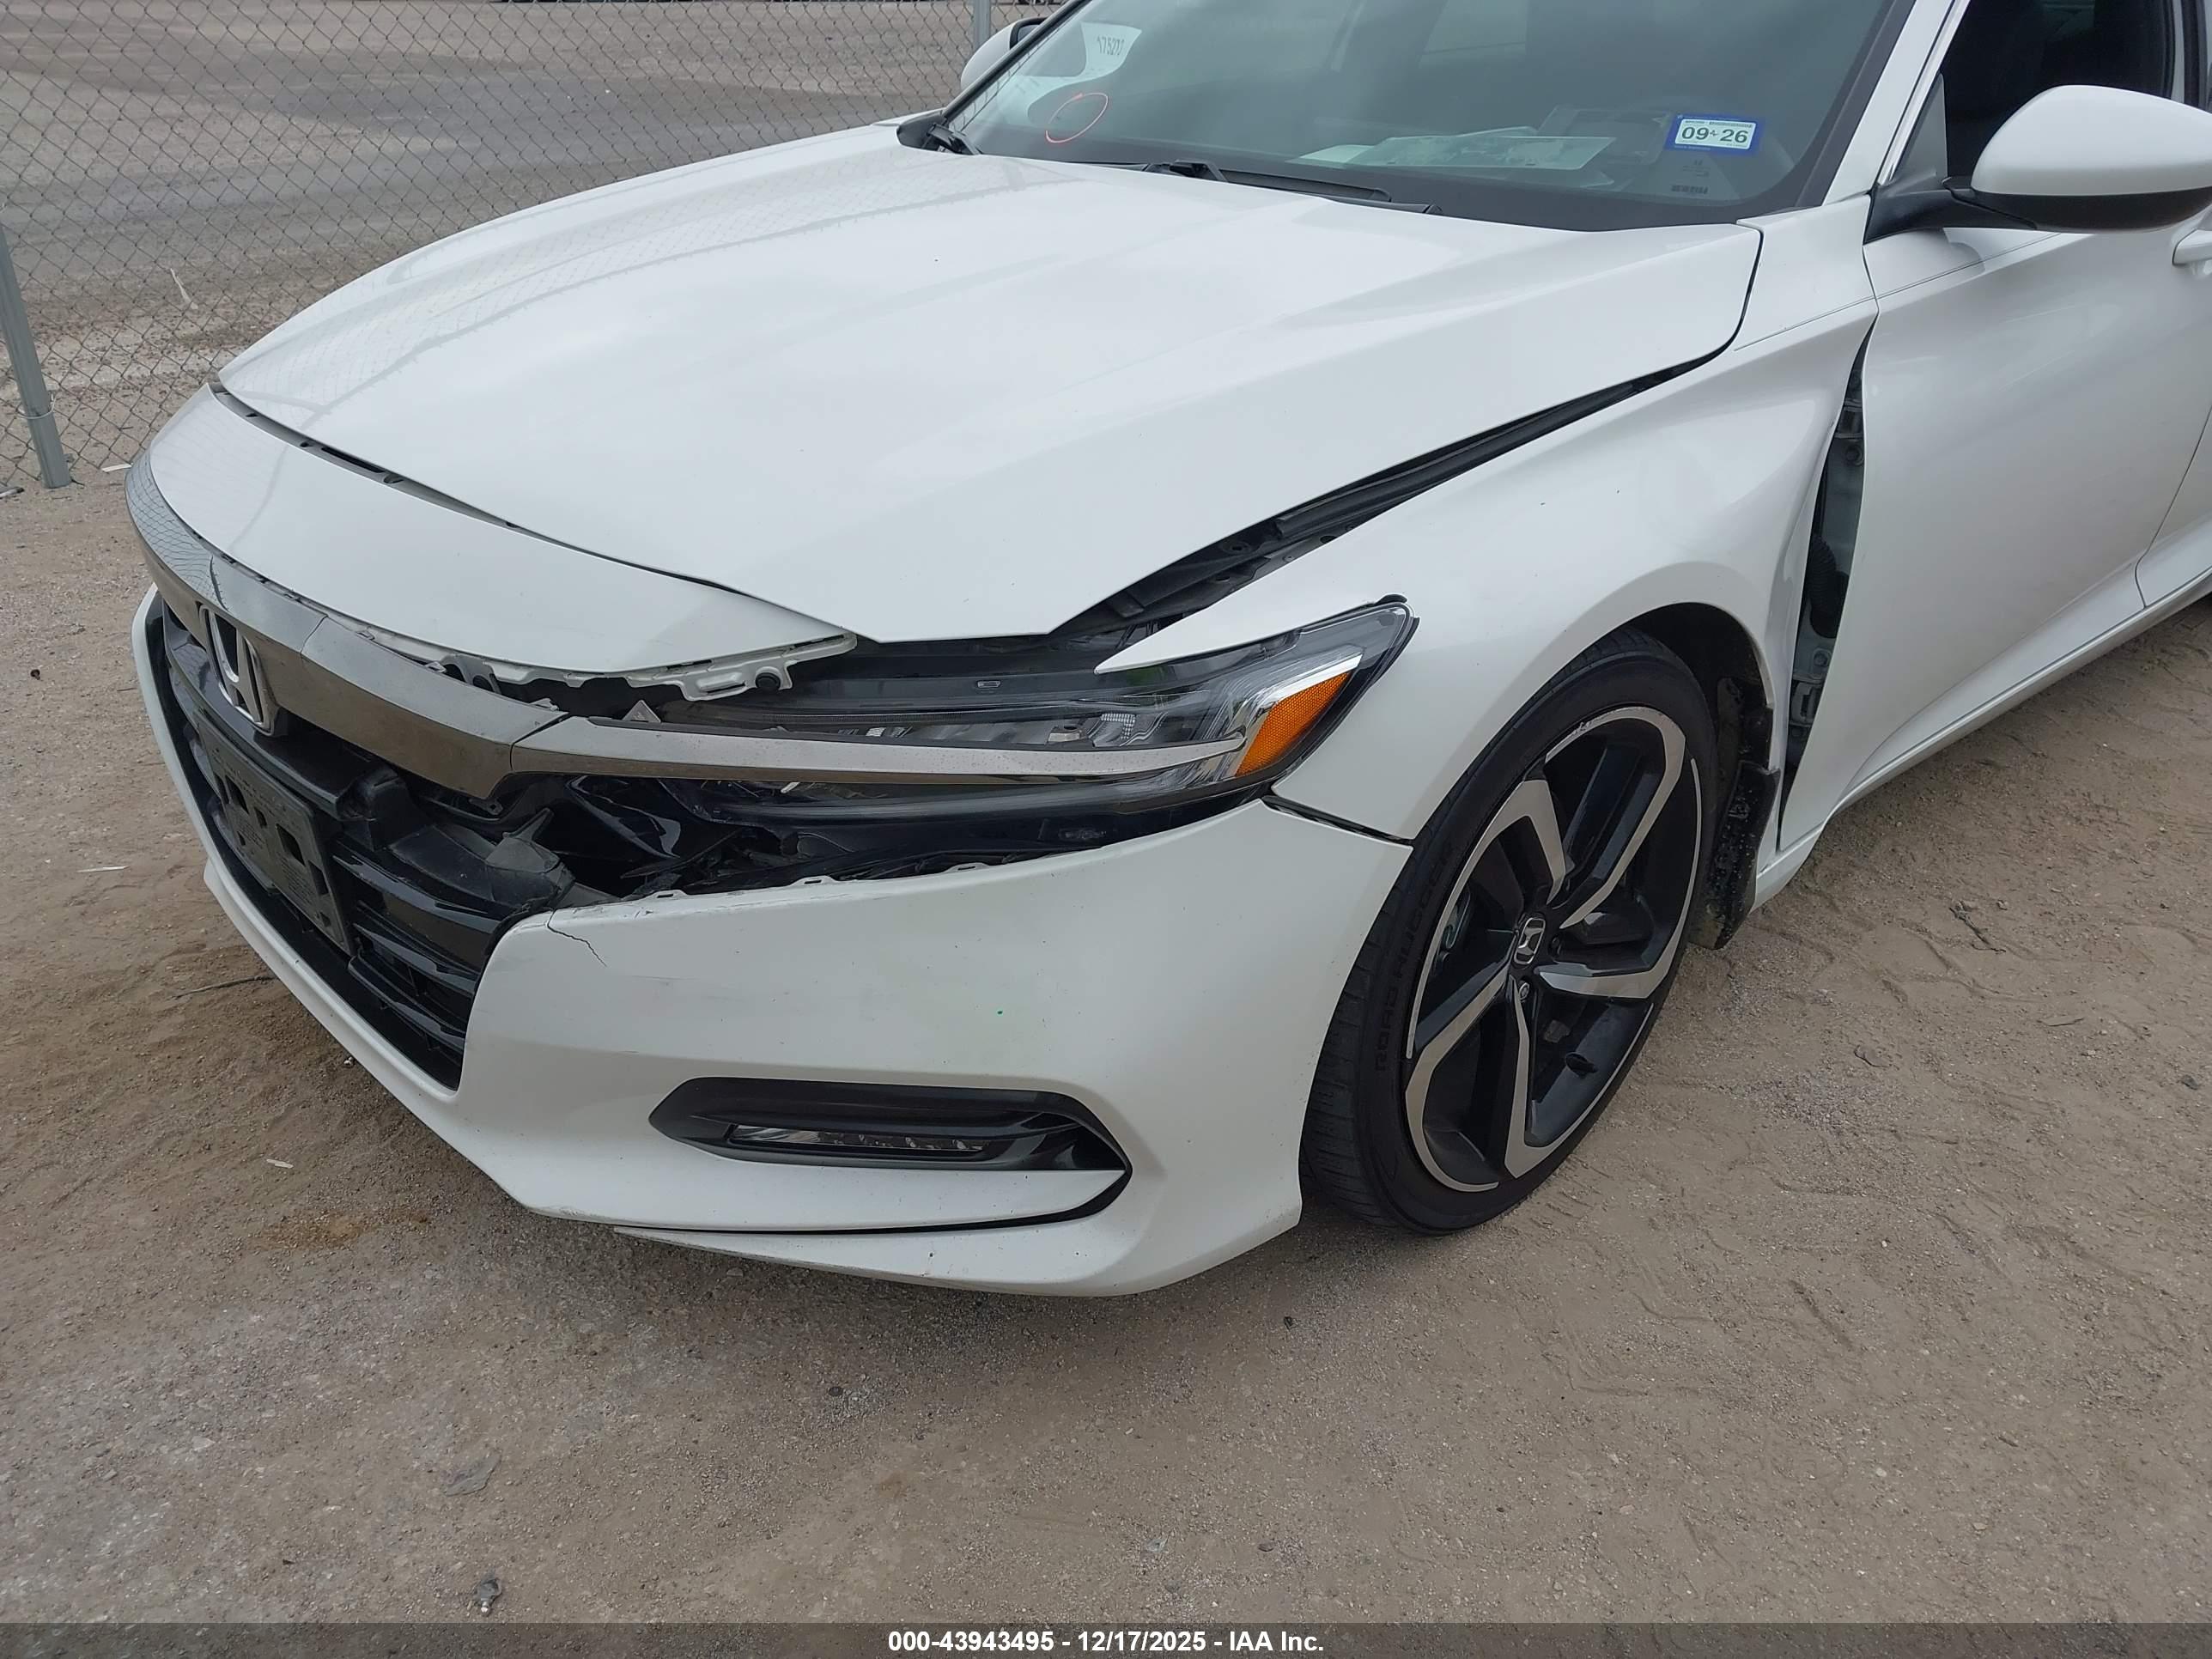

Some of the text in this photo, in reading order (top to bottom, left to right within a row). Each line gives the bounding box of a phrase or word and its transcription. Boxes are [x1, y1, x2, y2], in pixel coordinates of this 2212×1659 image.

[1681, 127, 1747, 143] 09 26
[1375, 841, 1451, 1072] ROAD HUGGER
